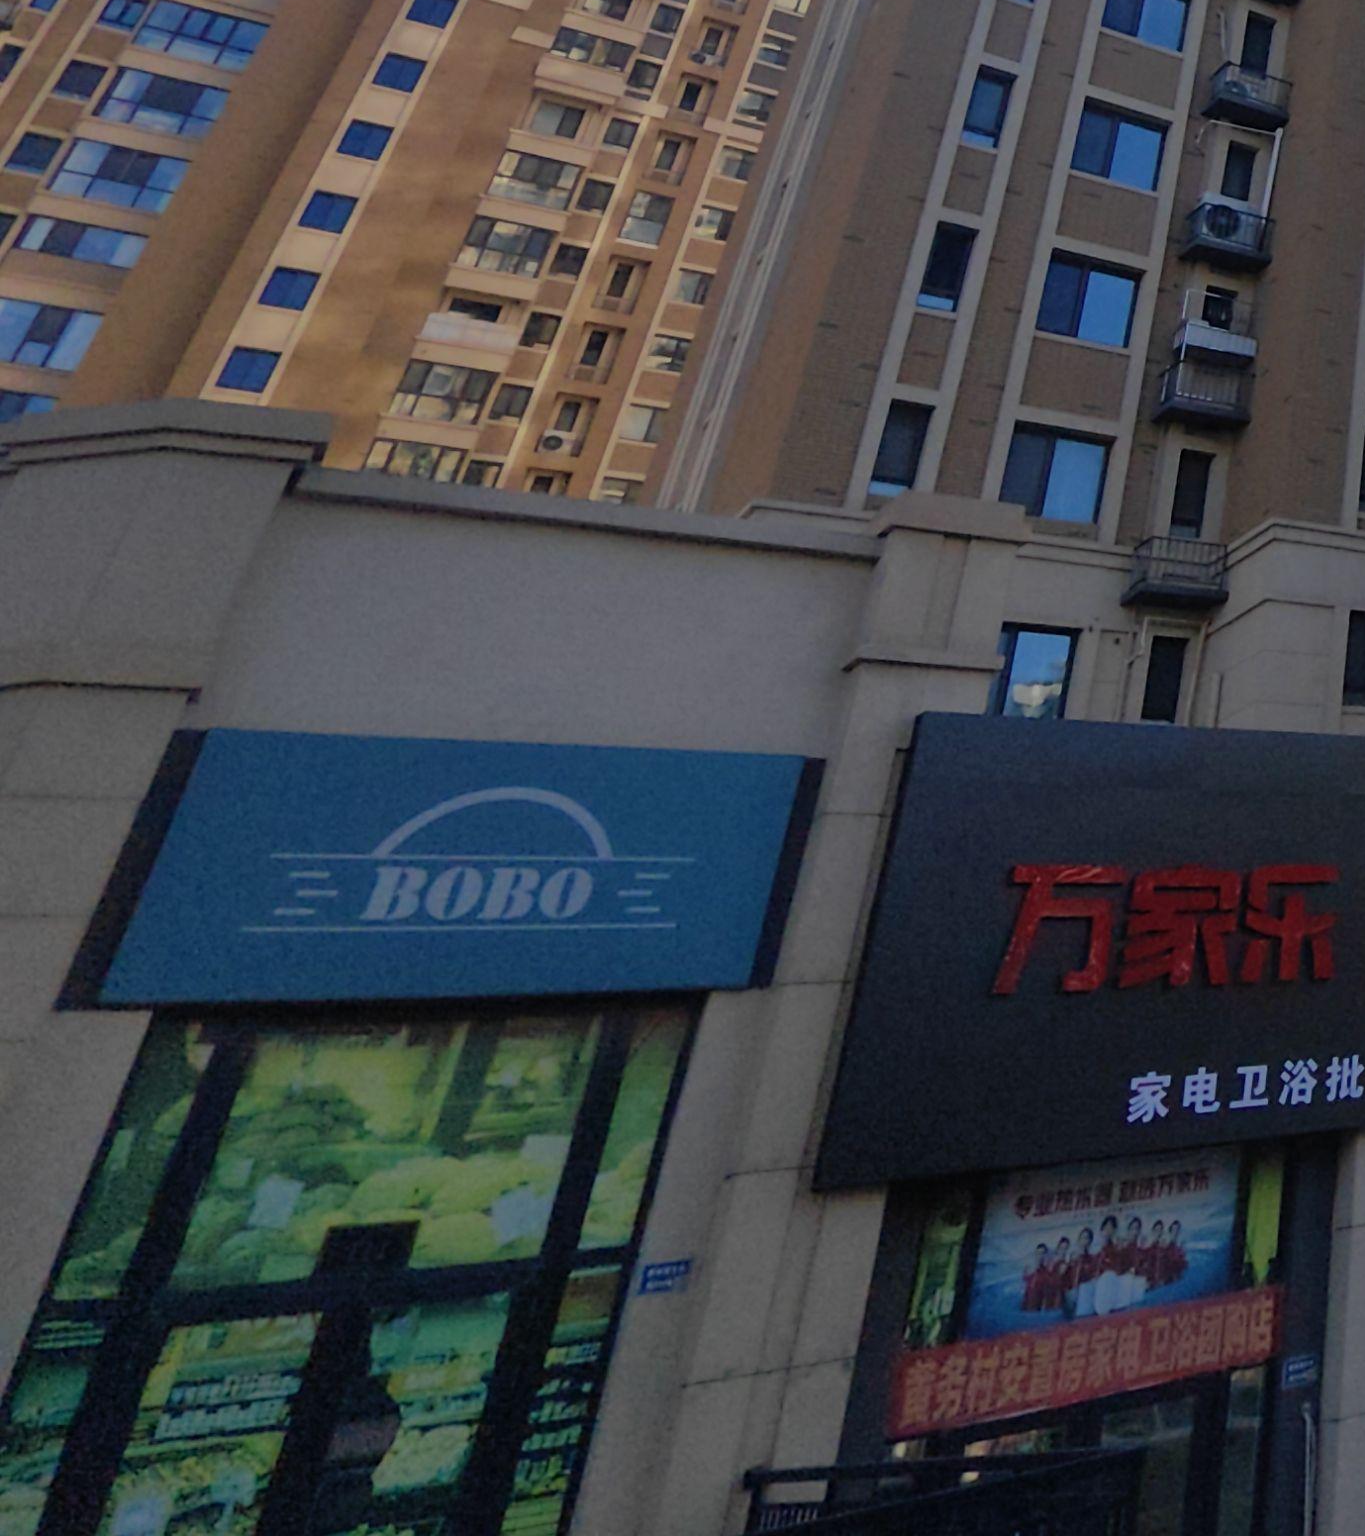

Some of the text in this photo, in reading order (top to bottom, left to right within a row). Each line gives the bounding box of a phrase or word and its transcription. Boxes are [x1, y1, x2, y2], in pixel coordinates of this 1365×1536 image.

[358, 864, 595, 924] BOBO
[993, 863, 1341, 996] 万家乐
